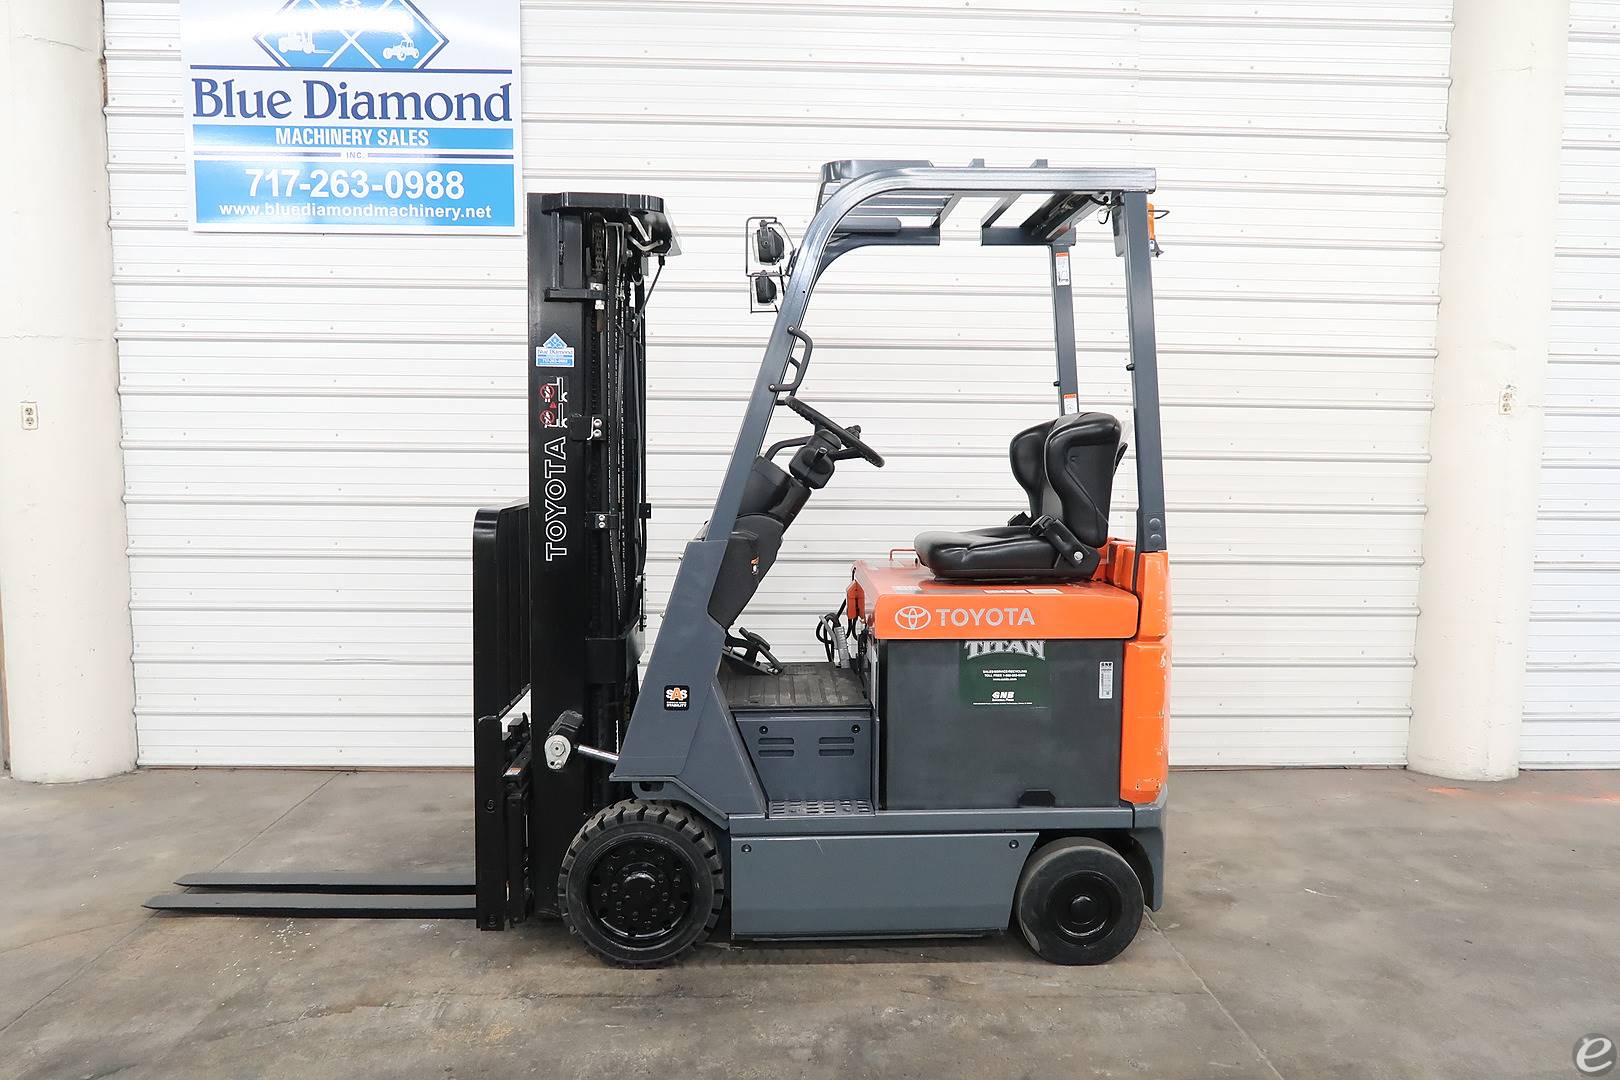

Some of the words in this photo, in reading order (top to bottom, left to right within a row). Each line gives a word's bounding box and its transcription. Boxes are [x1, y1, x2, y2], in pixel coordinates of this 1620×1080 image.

[192, 77, 292, 119] Blue
[303, 79, 513, 121] Diamond
[275, 127, 372, 146] MACHINERY
[377, 129, 429, 147] SALES
[244, 168, 465, 200] 717-263-0988
[219, 202, 492, 221] www.bluediamondmachinery.net
[544, 436, 567, 561] TOYOTA
[935, 607, 1036, 627] TOYOTA
[963, 640, 1046, 661] TITAN
[665, 687, 688, 701] SAS
